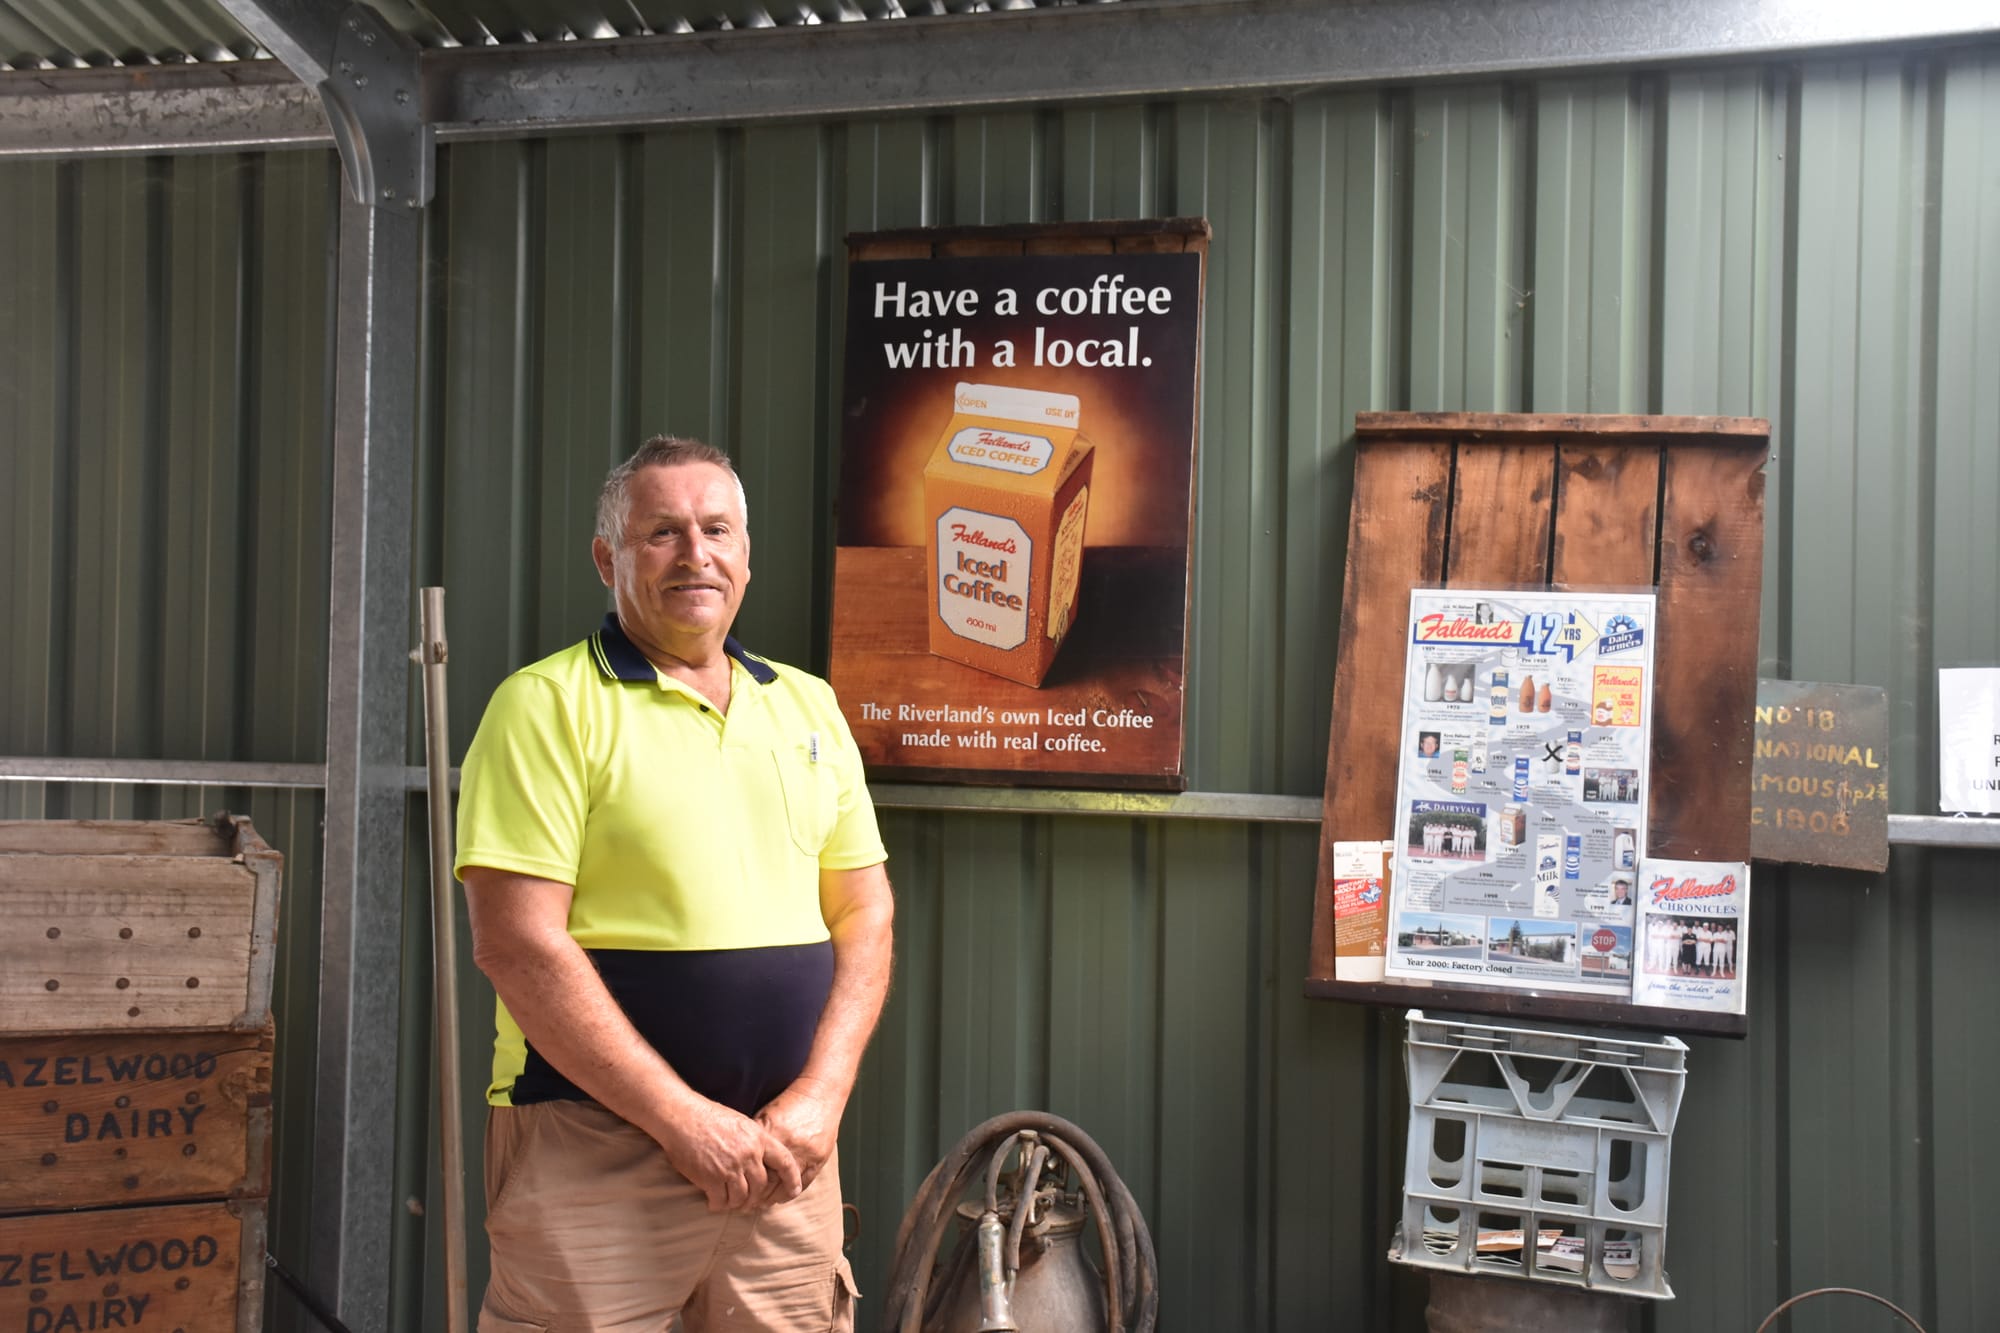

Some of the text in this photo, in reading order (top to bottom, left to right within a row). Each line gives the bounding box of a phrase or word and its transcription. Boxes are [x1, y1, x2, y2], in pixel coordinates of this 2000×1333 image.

[874, 273, 1172, 318] Have a coffee
[884, 326, 1152, 369] with a local.
[963, 398, 987, 409] OPEN
[1045, 407, 1062, 418] USE
[955, 445, 1041, 467] ICED COFFEE
[951, 523, 1016, 554] Falland's
[957, 551, 1007, 582] Iced
[943, 573, 1023, 611] Coffee
[1421, 611, 1581, 654] Falland's 42 YRS
[1608, 633, 1634, 645] Dairy
[1601, 639, 1641, 654] Farmers
[860, 703, 1154, 729] The Riverland's own Iced Coffee
[902, 731, 1107, 753] made with real coffee.
[1433, 803, 1481, 814] DAIRYVALE
[1536, 871, 1559, 883] Milk
[1651, 874, 1736, 903] Falland's
[1659, 902, 1737, 913] CHRONICLES
[1592, 935, 1616, 946] STOP
[1407, 957, 1424, 967] Year
[1427, 960, 1450, 969] 2000:
[1452, 962, 1483, 973] Factory
[1486, 963, 1513, 974] closed
[1669, 982, 1681, 991] the
[1715, 985, 1731, 994] side
[0, 1052, 217, 1088] AZELWOOD
[65, 1104, 206, 1143] DAIRY
[0, 1234, 218, 1287] ZELWOOD
[27, 1294, 150, 1333] DAIRY
